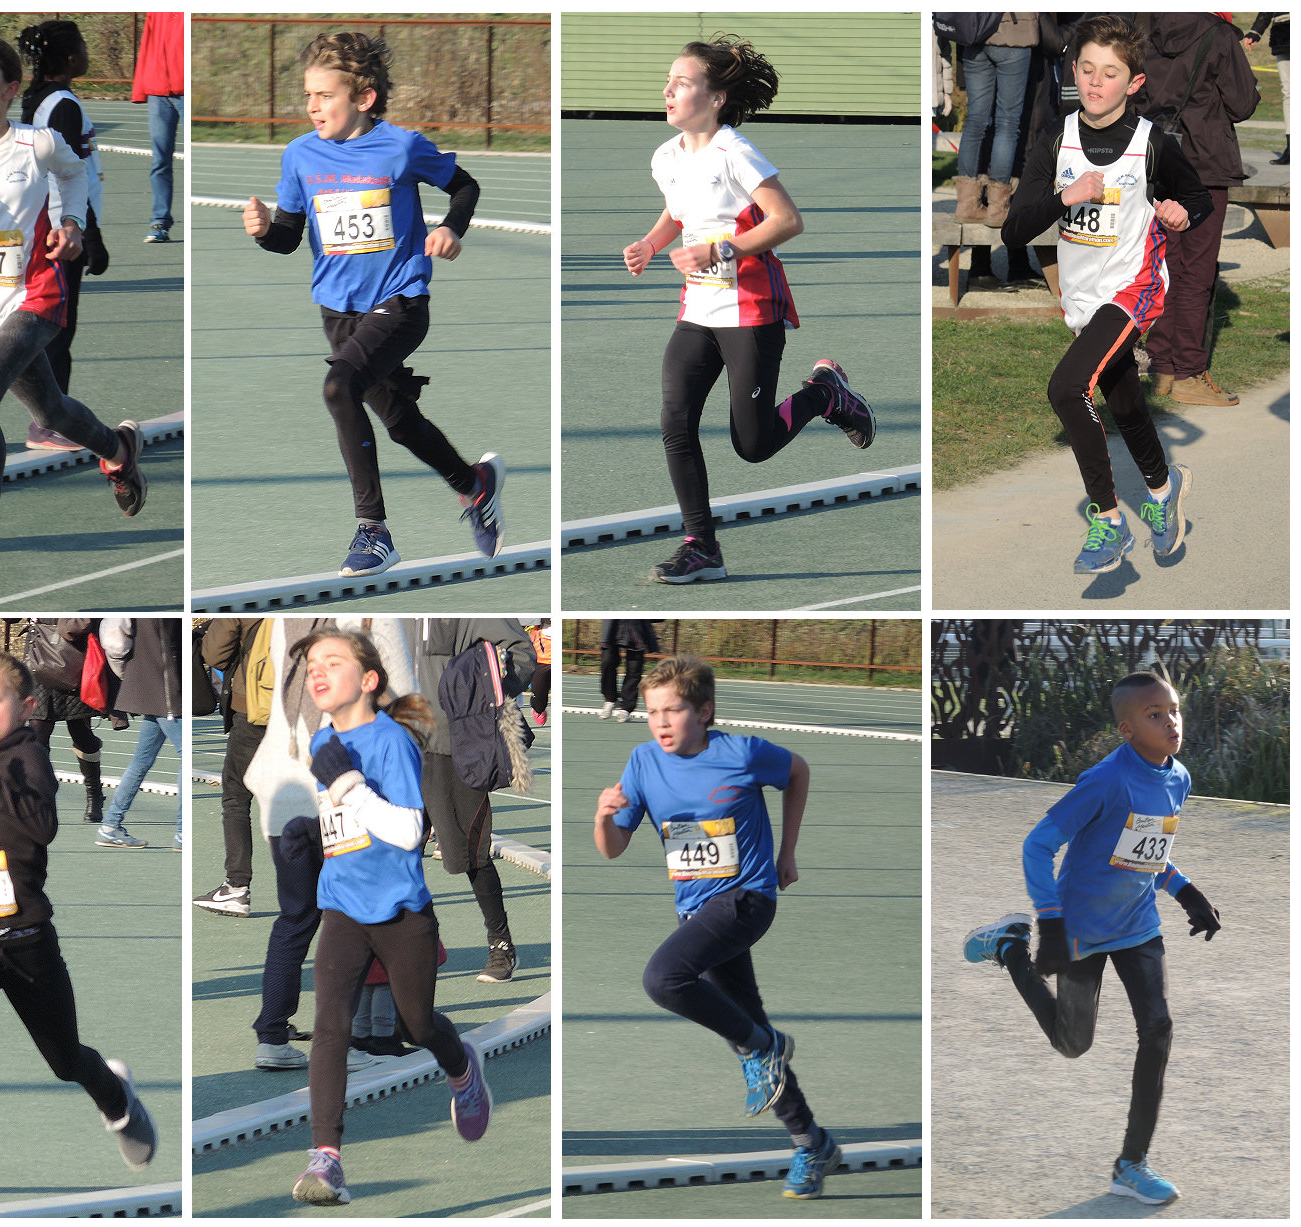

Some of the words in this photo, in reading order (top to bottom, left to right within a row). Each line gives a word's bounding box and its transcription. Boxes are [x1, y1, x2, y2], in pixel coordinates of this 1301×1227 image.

[334, 213, 375, 241] 453
[1062, 206, 1101, 233] 448
[321, 811, 346, 842] 447
[679, 842, 721, 867] 449
[1131, 836, 1168, 861] 433
